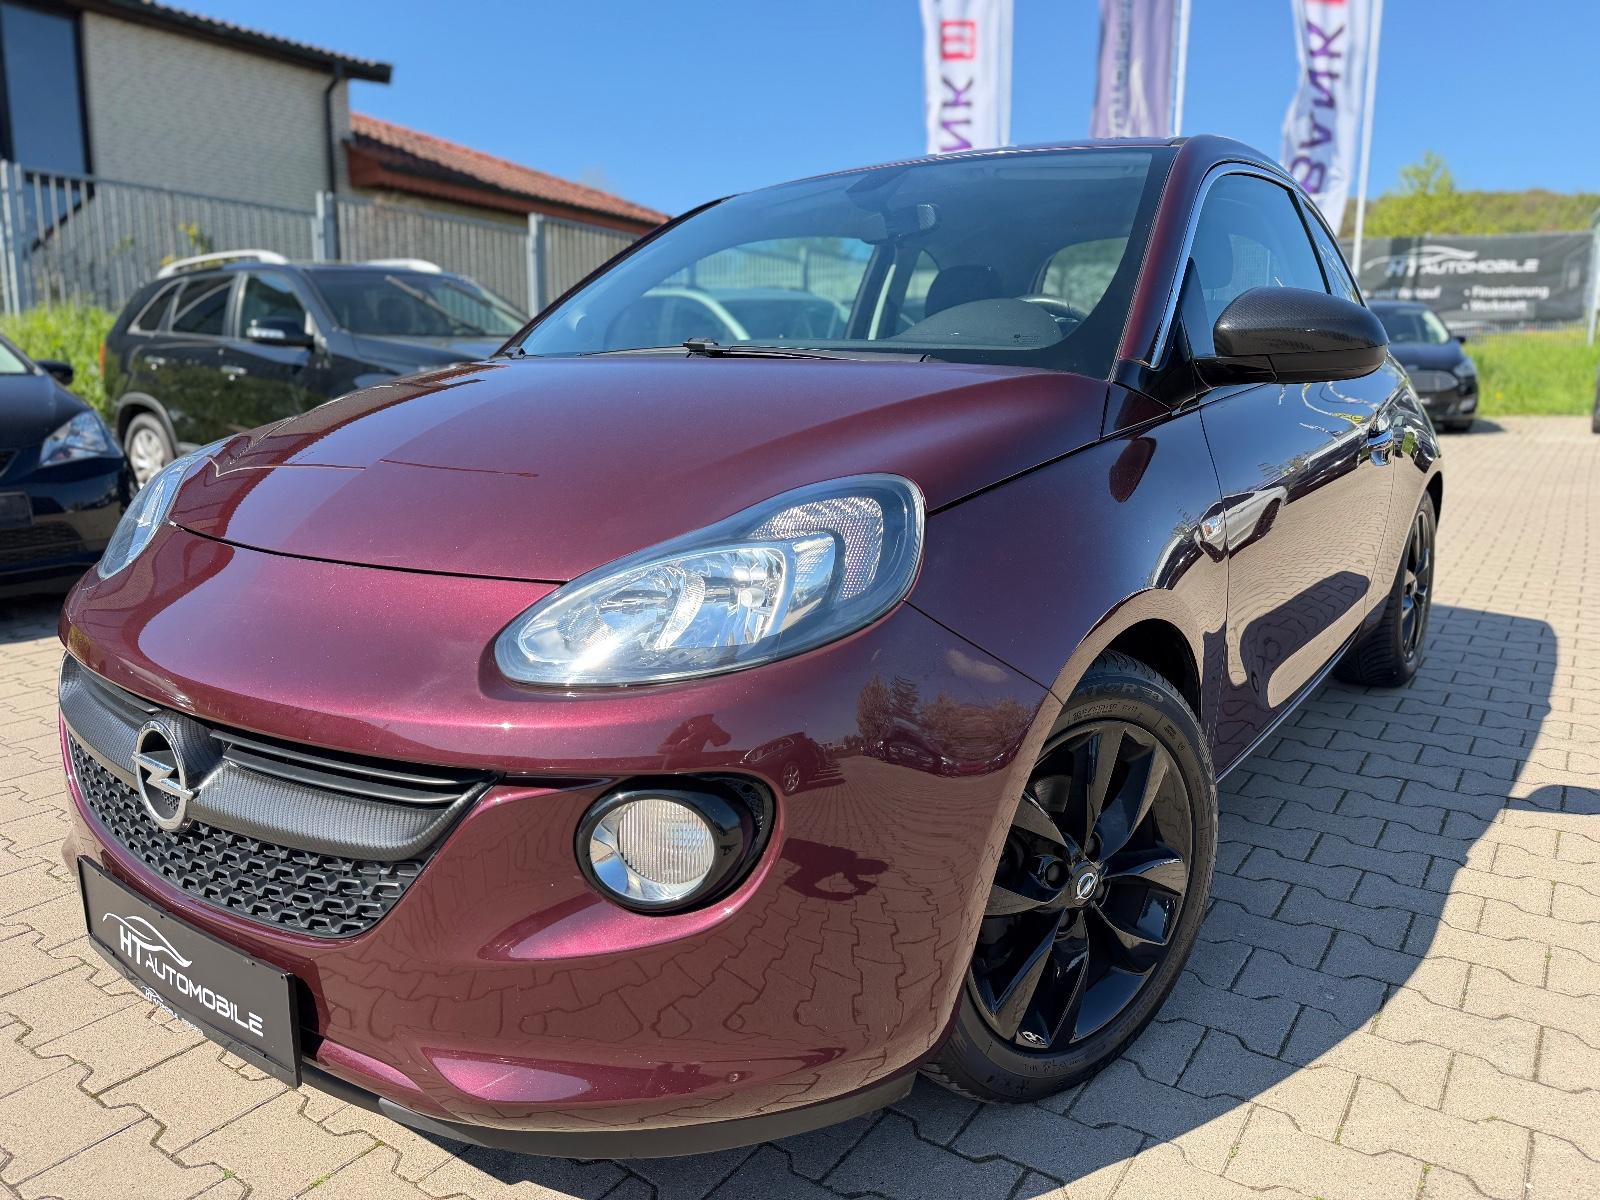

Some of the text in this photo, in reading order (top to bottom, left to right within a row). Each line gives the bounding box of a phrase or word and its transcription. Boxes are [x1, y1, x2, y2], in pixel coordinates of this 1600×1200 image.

[1422, 258, 1539, 275] AUTOMOBILE
[1472, 284, 1550, 300] Finanzierung
[119, 924, 264, 1037] HT AUTOMOBILE
